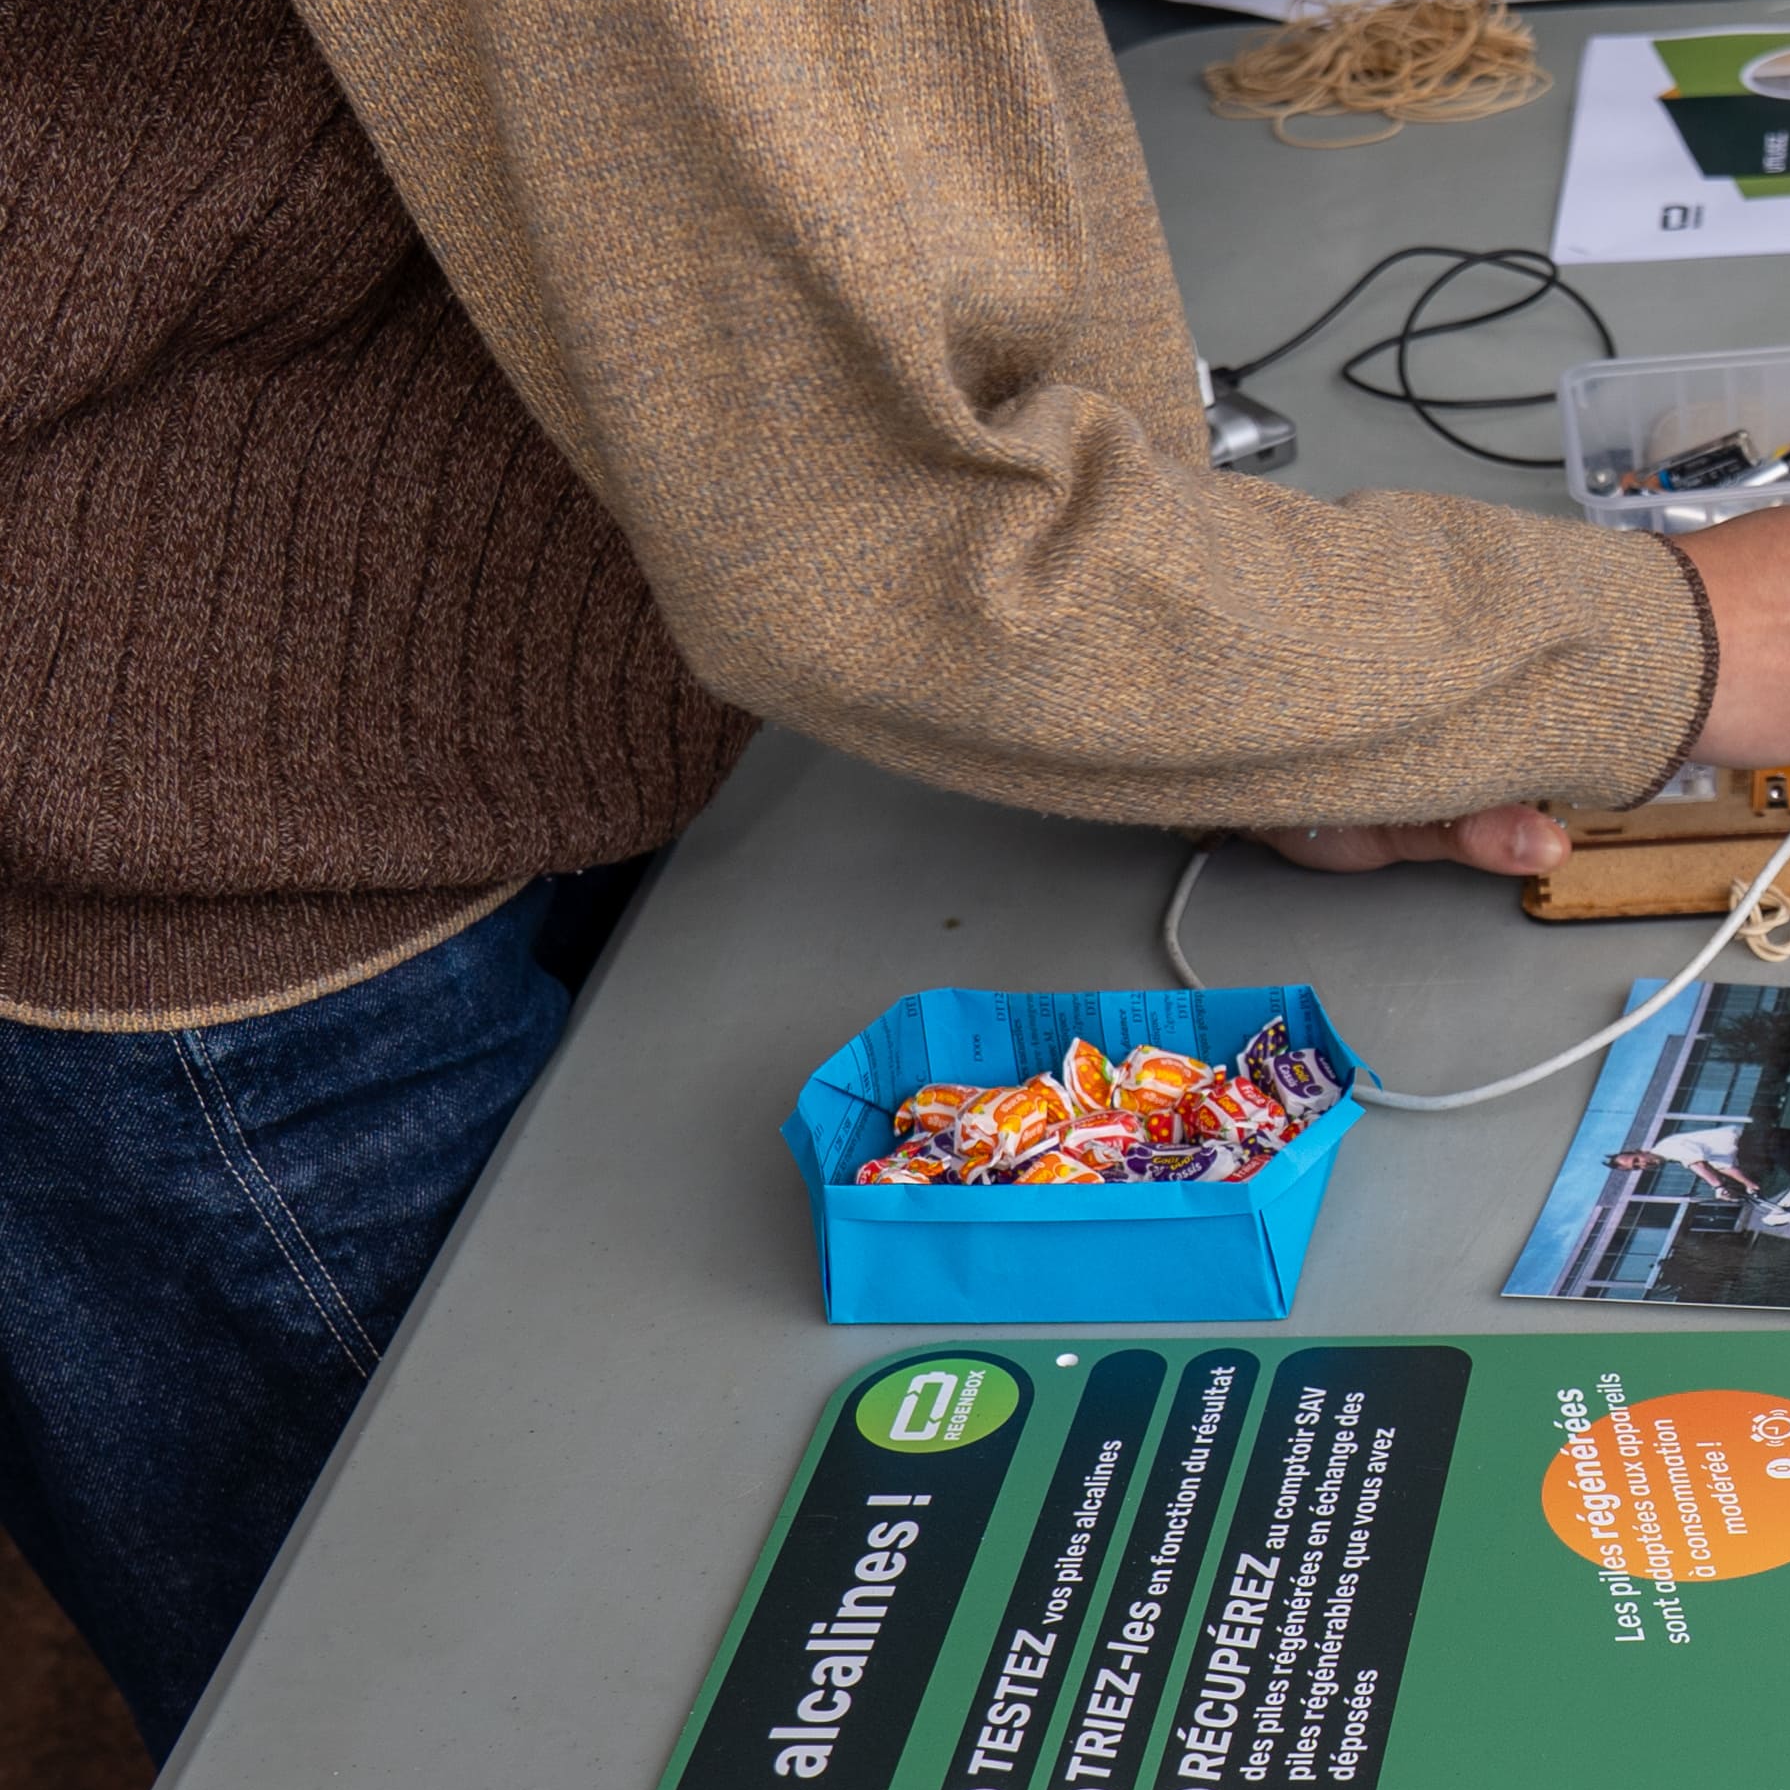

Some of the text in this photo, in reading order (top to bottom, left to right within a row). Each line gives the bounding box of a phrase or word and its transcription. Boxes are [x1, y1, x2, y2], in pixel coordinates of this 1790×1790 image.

[943, 1369, 986, 1441] REGENBOX
[1191, 1365, 1237, 1444] résultat
[1295, 1385, 1328, 1425] SAV
[1075, 1438, 1123, 1528] alcalines
[1182, 1447, 1210, 1474] du
[1273, 1427, 1317, 1522] comptoir
[1652, 1418, 1717, 1579] à consommation
[1700, 1450, 1748, 1535] modérée
[1151, 1477, 1201, 1566] fonction
[1264, 1524, 1287, 1550] au
[1554, 1387, 1645, 1643] Les piles régénérées
[1596, 1372, 1690, 1644] sont adaptées aux appareils
[1056, 1532, 1090, 1583] piles
[1147, 1567, 1174, 1596] en
[1239, 1391, 1366, 1781] des piles régénérées en échange des
[769, 1521, 919, 1780] alcalines
[867, 1492, 933, 1510] !
[1042, 1586, 1071, 1625] vos
[1284, 1427, 1396, 1781] piles régénérables que vous avez
[967, 1628, 1057, 1776] TESTEZ
[1065, 1600, 1162, 1782] TRIEZ-les
[1176, 1552, 1280, 1781] RÉCUPÉREZ
[1327, 1669, 1379, 1781] déposées
